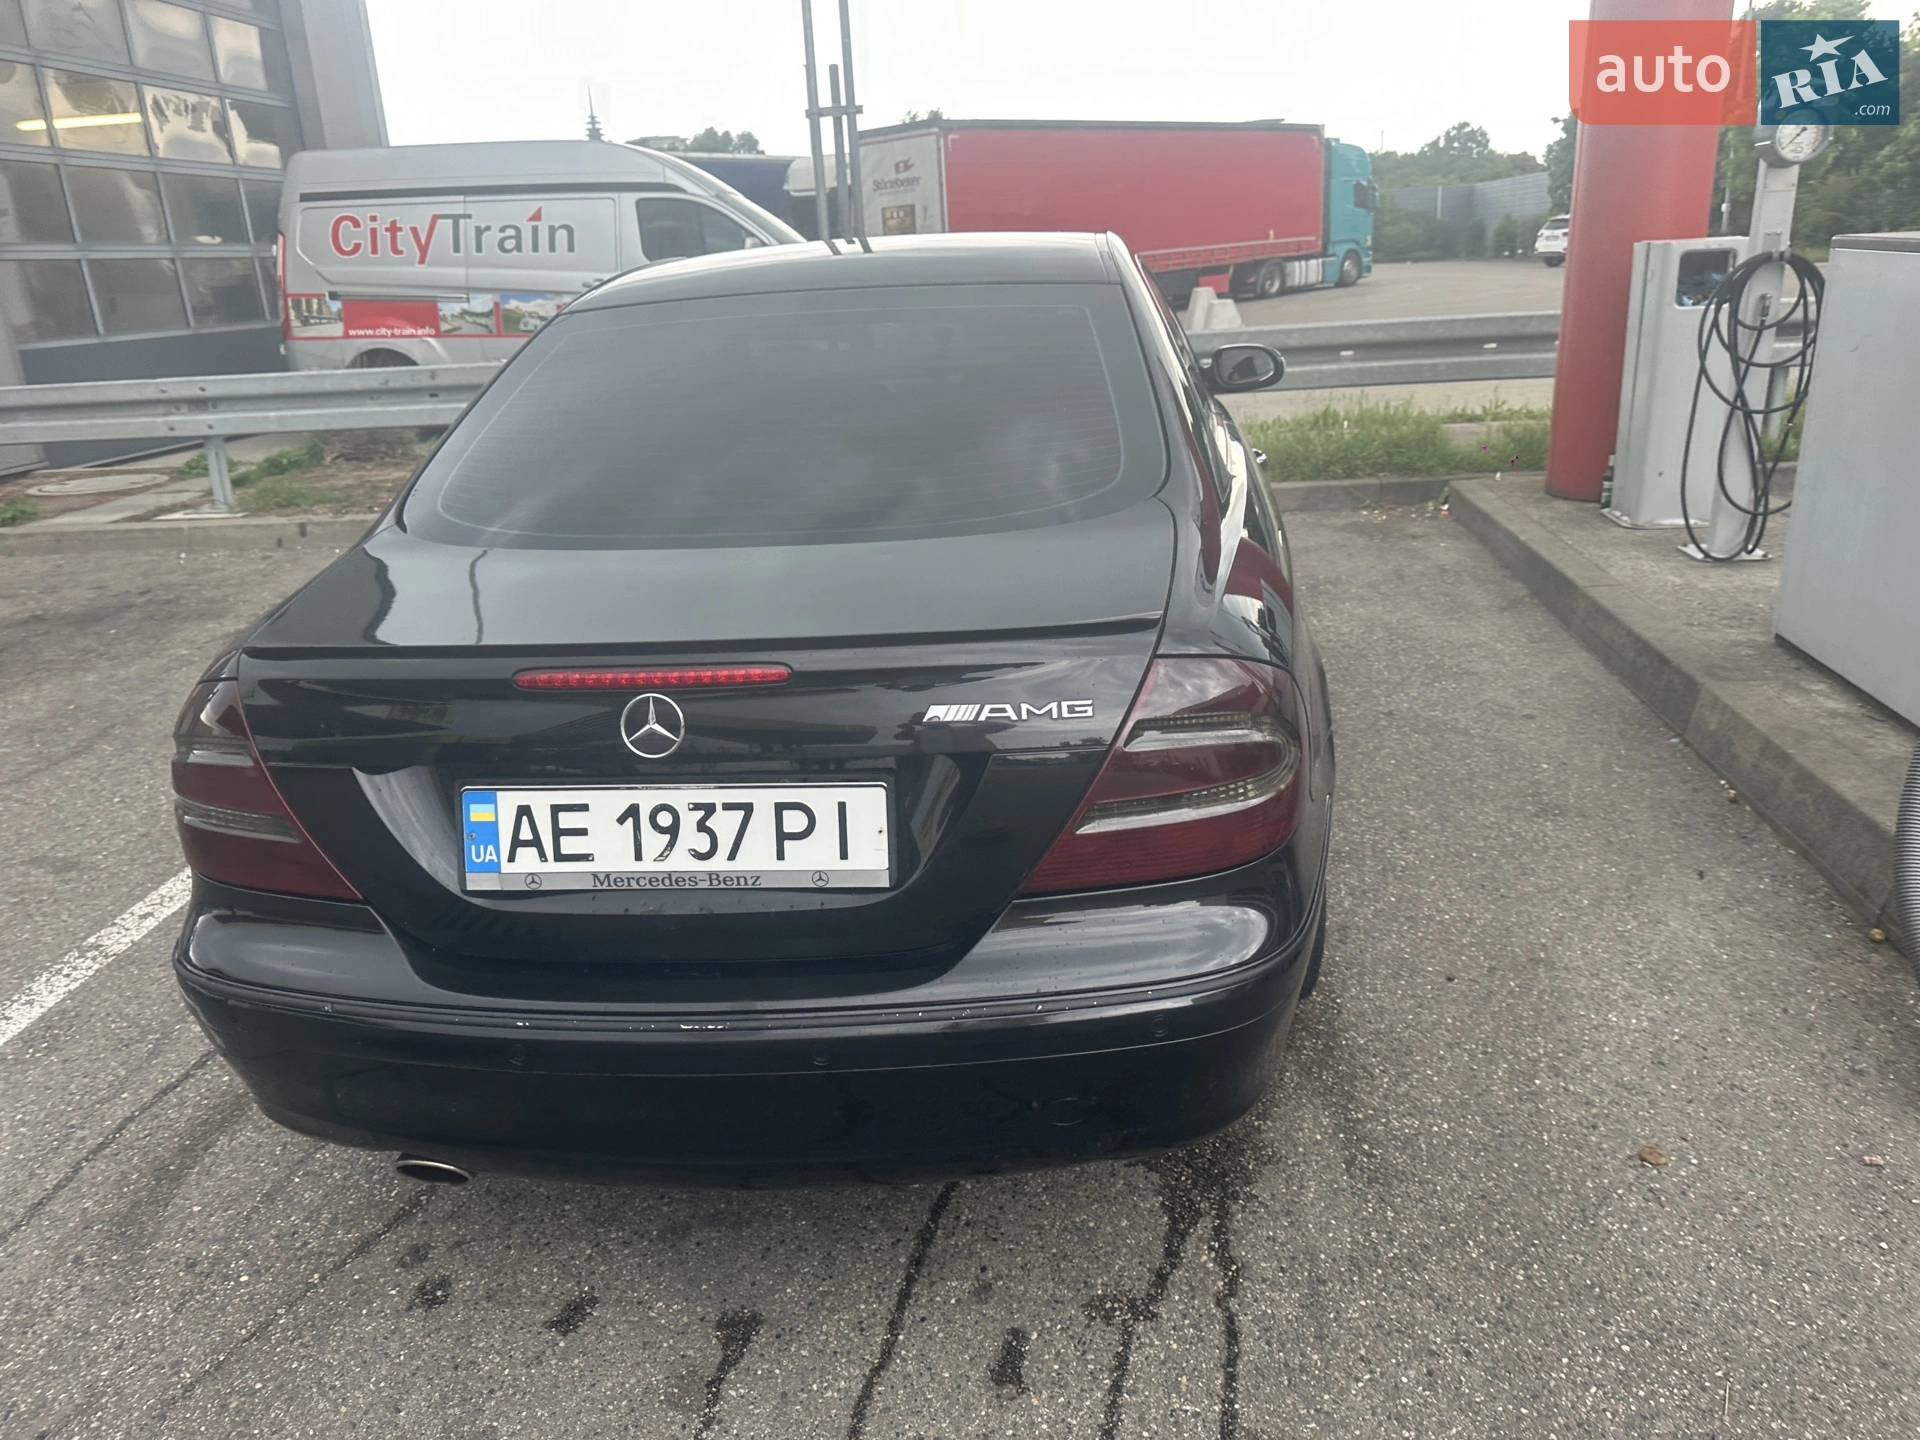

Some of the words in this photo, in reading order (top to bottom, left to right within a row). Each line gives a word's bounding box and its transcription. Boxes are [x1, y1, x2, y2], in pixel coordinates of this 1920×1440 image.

[330, 205, 576, 266] CityTrain
[348, 327, 436, 337] www.city-train.info
[977, 700, 1093, 722] AMG
[507, 803, 595, 863] AE
[616, 802, 754, 862] 1937
[774, 801, 849, 861] PI
[471, 844, 498, 863] UA
[591, 873, 762, 888] Mercedes-Benz
